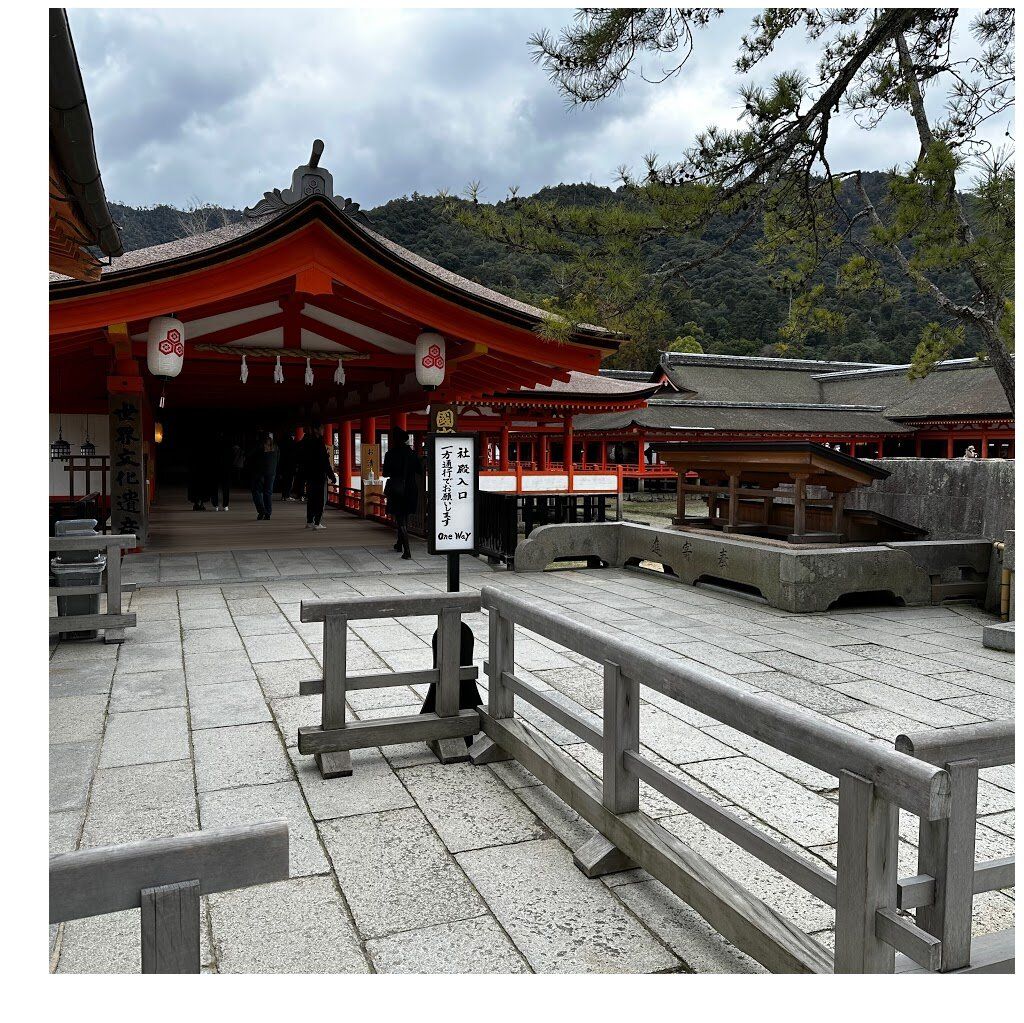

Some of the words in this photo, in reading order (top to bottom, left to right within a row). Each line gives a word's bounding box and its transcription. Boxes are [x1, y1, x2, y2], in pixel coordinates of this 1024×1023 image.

[440, 445, 454, 527] 一方通行でお願いします
[456, 447, 471, 500] 社殿入口
[437, 532, 453, 541] One
